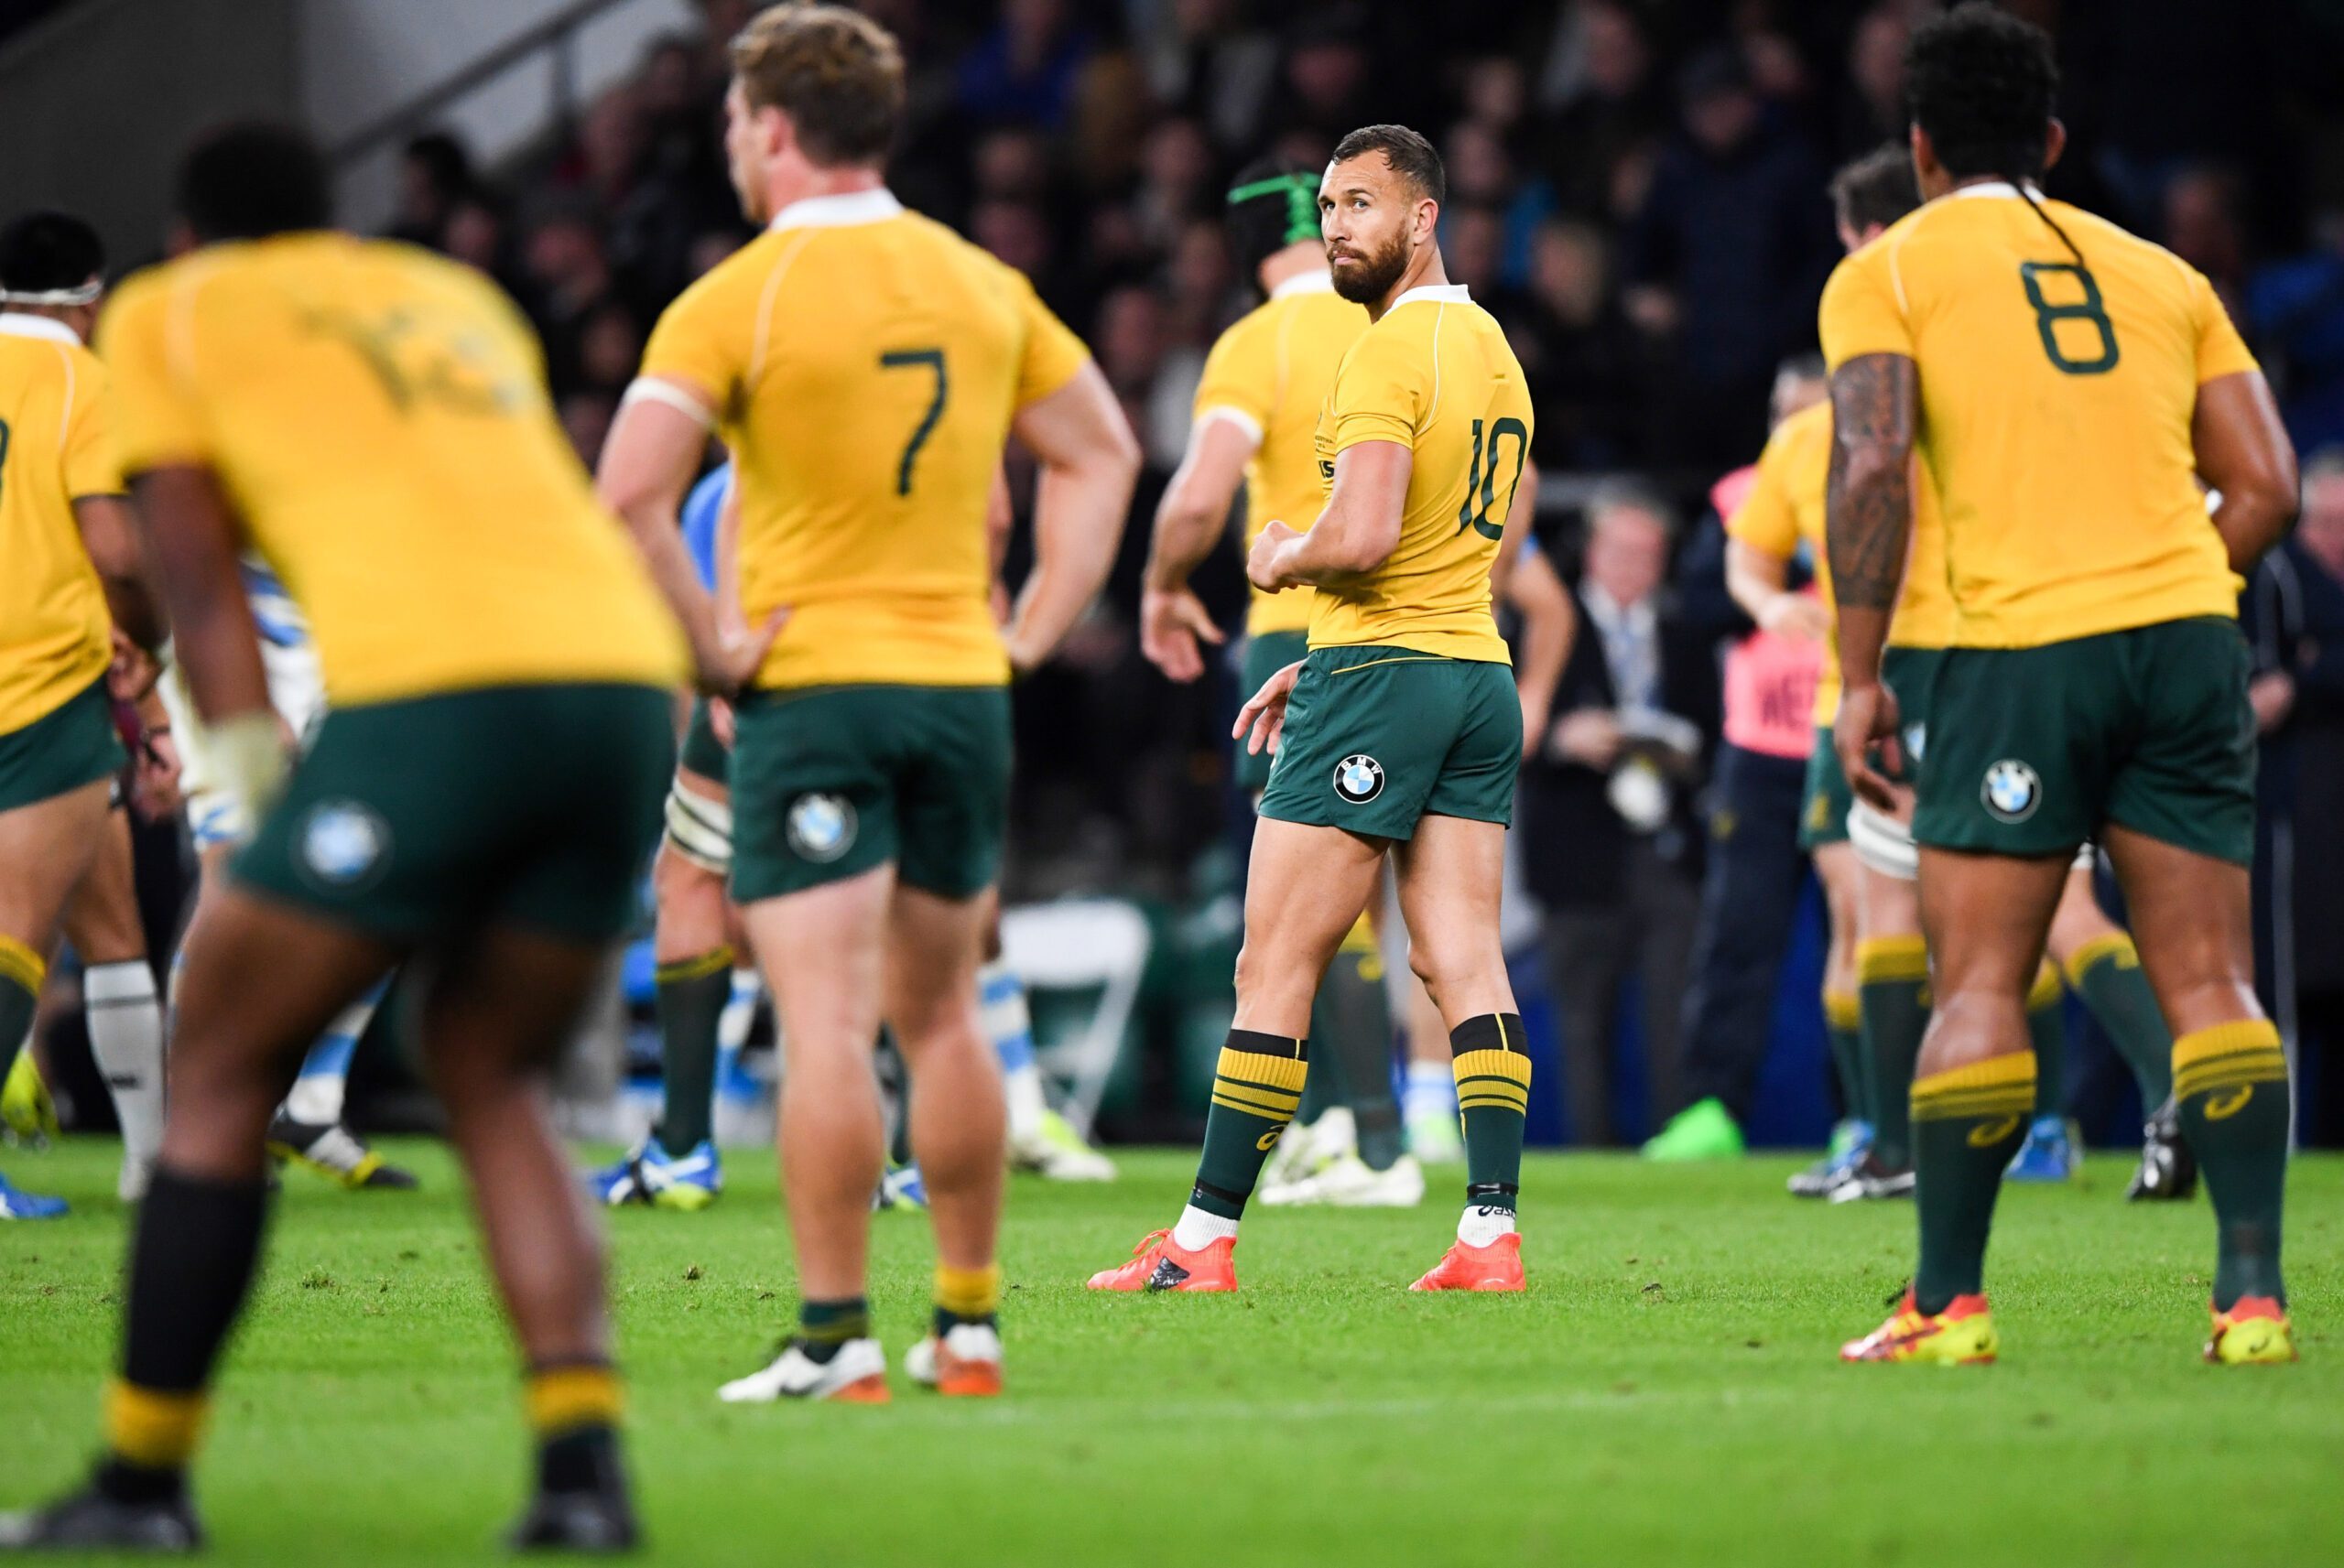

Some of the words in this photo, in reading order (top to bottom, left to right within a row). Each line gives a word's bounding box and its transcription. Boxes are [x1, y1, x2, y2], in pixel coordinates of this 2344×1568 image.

[2020, 262, 2121, 375] 8
[880, 349, 949, 496] 7
[1456, 417, 1527, 541] 10
[1340, 756, 1381, 774] BMW
